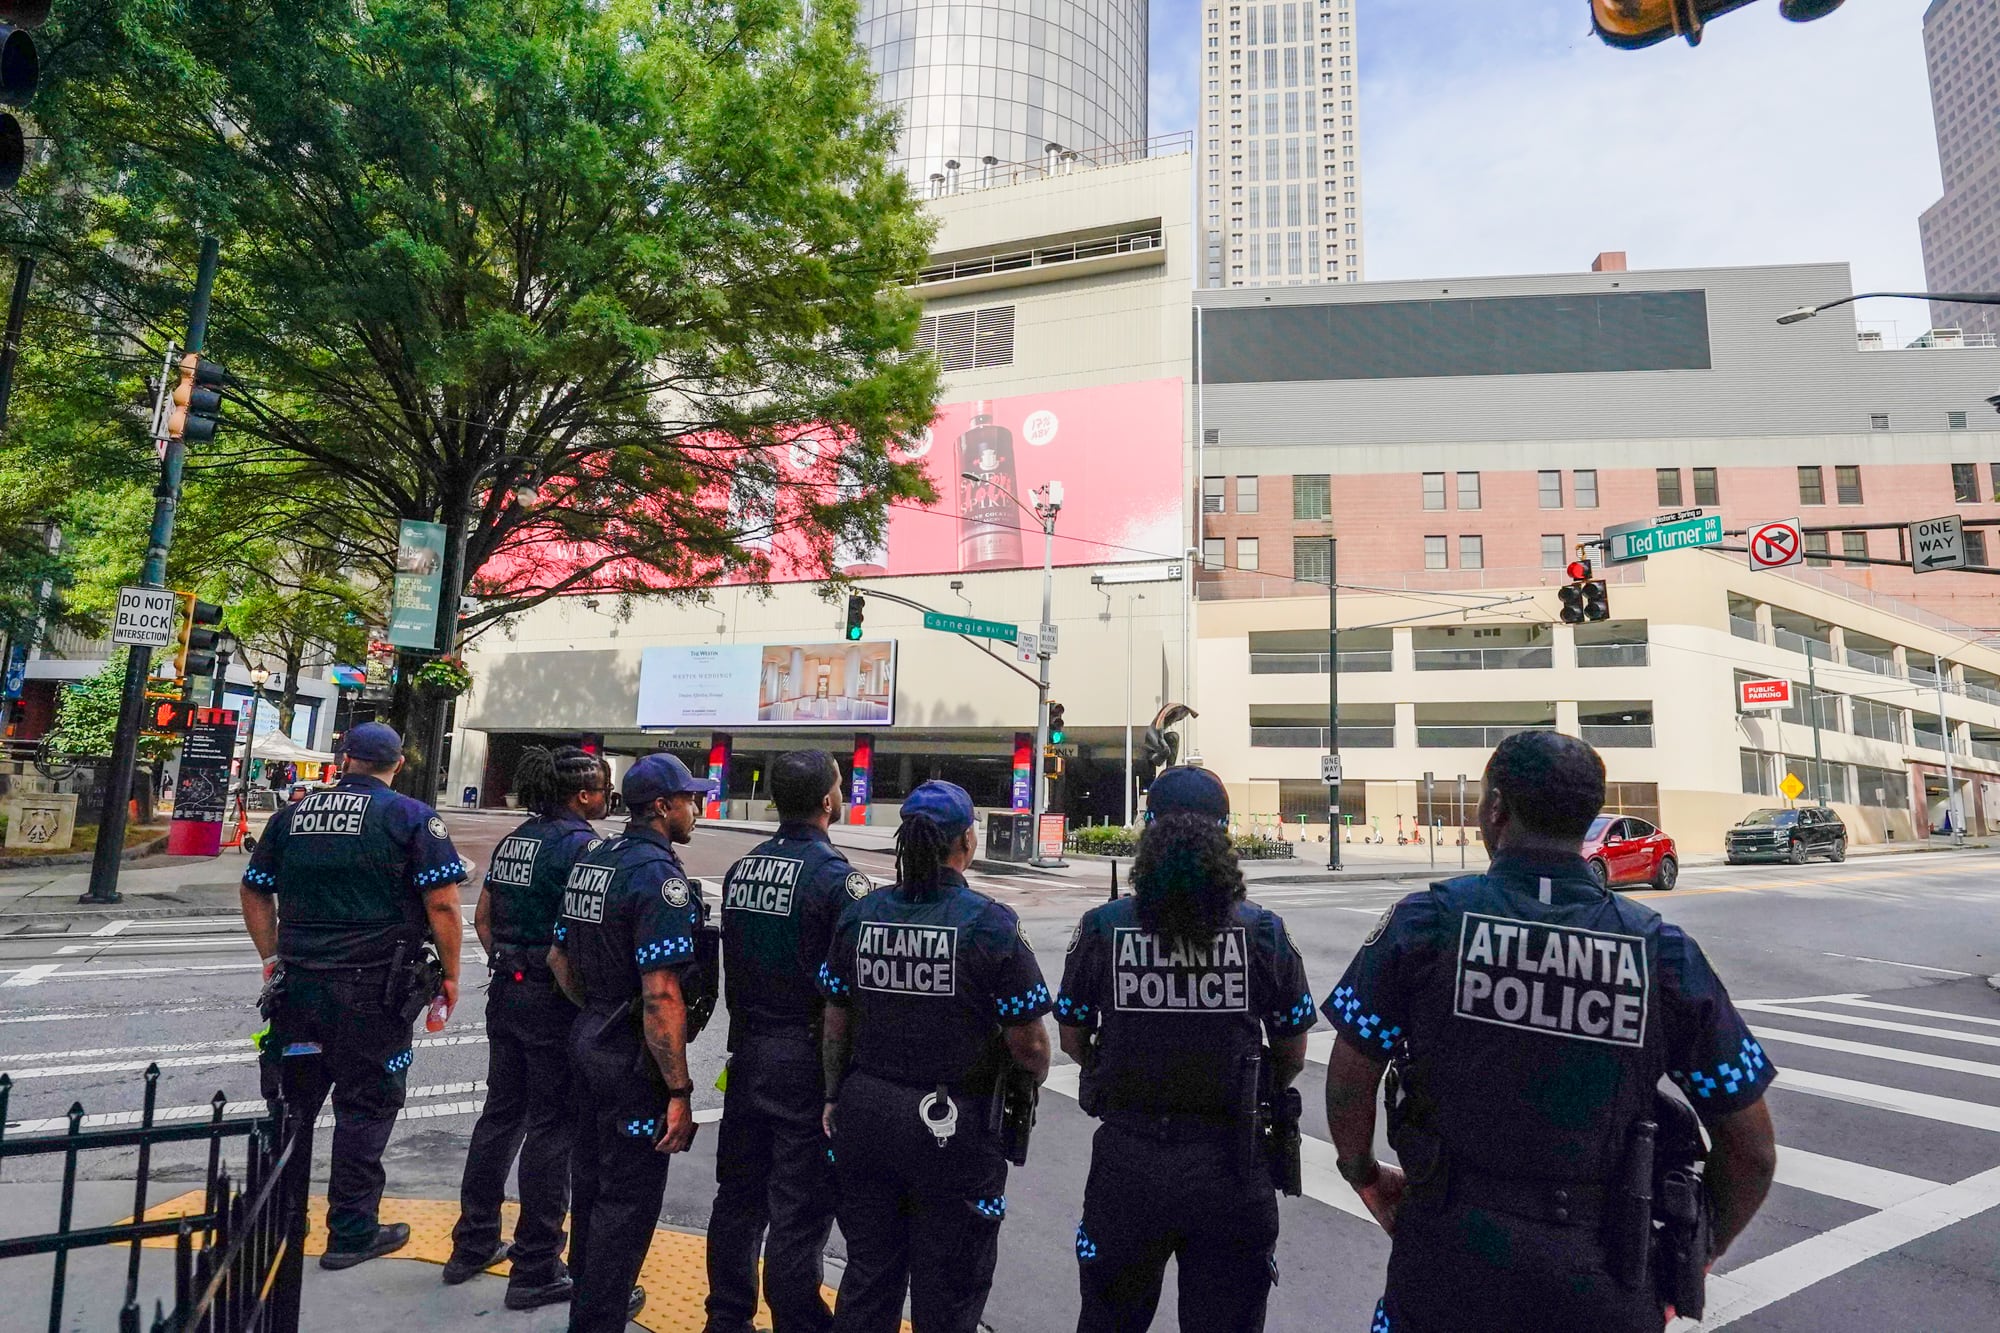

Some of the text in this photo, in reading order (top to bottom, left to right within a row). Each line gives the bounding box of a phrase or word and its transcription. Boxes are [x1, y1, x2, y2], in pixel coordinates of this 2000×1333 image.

[1677, 510, 1695, 520] Spring
[1705, 519, 1716, 530] DR
[1705, 531, 1717, 542] NW
[1919, 520, 1953, 536] ONE
[1629, 527, 1702, 554] Ted Turner
[1919, 535, 1954, 553] WAY
[122, 594, 173, 611] DO NOT
[119, 612, 169, 629] BLOCK
[926, 615, 1015, 637] Carnegie WAY NW
[116, 628, 167, 641] INTERSECTION
[1023, 635, 1033, 643] NO
[1748, 685, 1776, 693] PUBLIC
[1748, 691, 1782, 700] PARKING
[658, 739, 702, 749] ENTRANCE
[1324, 757, 1339, 765] ONE
[1324, 765, 1338, 773] WAY
[297, 794, 364, 812] ATLANTA
[292, 813, 361, 833] POLICE
[497, 839, 535, 861] ALANTA
[493, 860, 531, 883] POLICE
[567, 866, 609, 893] TLANTA
[733, 858, 796, 885] ATLANTA
[564, 891, 603, 920] OLICE
[726, 883, 792, 913] POLICE
[859, 926, 951, 960] ATLANTA
[1118, 932, 1244, 967] ATLANTA
[1466, 921, 1642, 988] ATLANTA
[859, 958, 951, 992] POLICE
[1117, 971, 1244, 1008] POLICE
[1461, 968, 1641, 1040] POLICE
